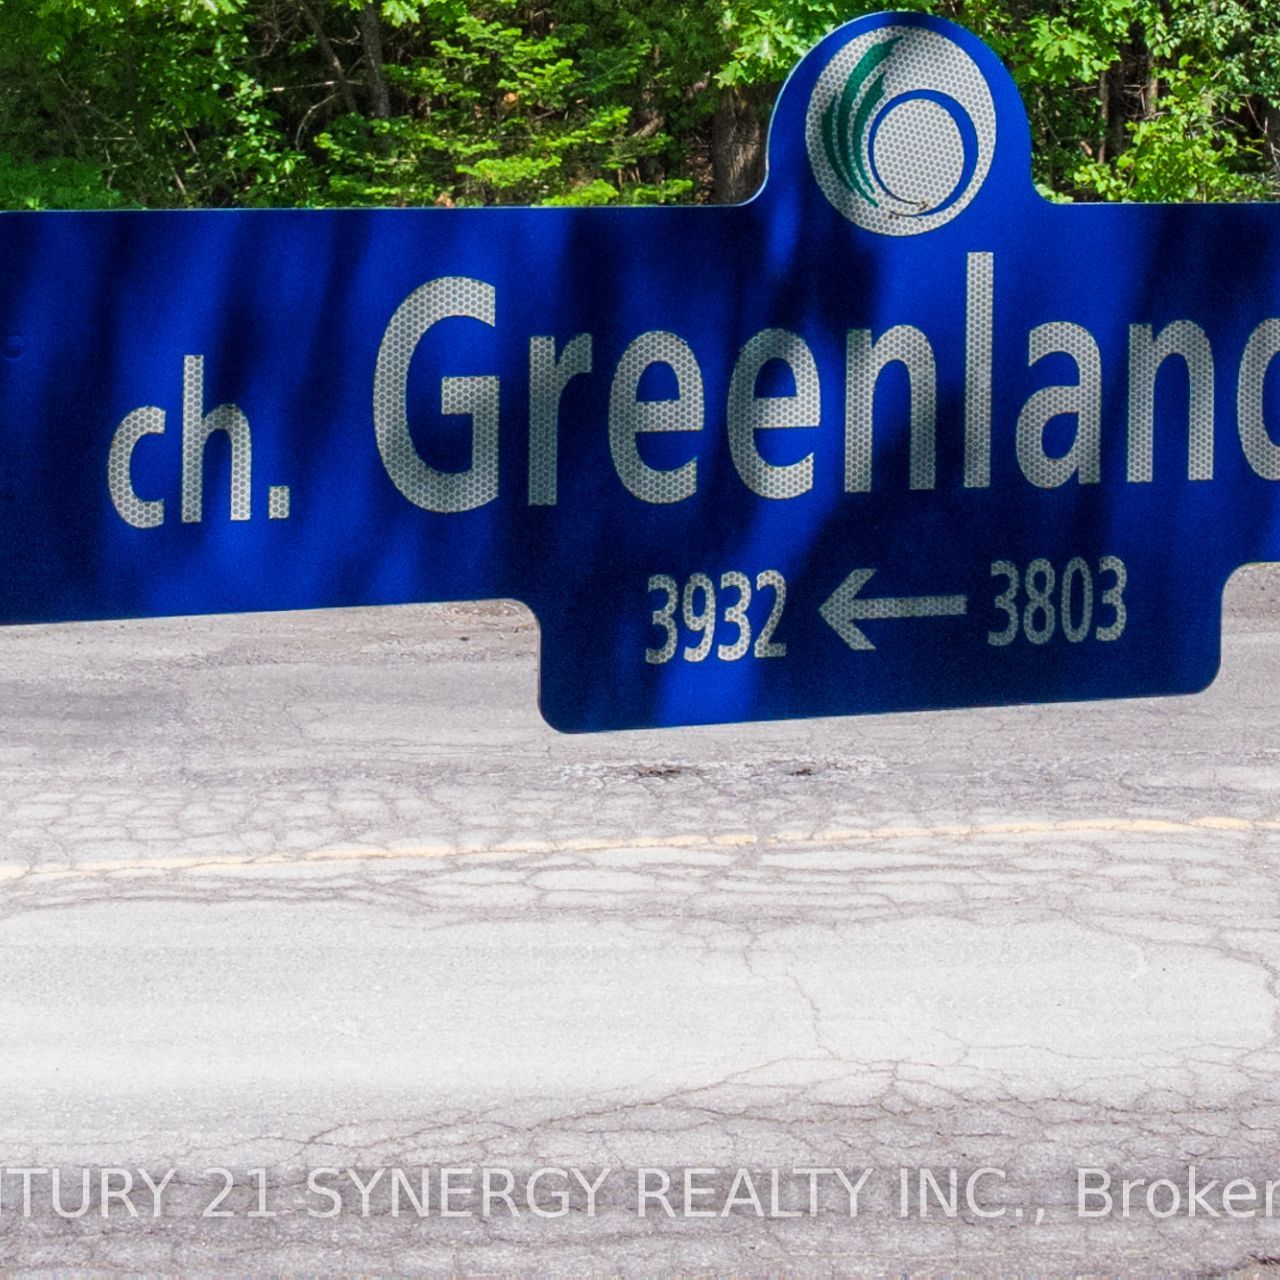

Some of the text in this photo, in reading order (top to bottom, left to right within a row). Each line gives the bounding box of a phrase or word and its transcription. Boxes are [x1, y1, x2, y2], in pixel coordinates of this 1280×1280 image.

[107, 354, 291, 529] ch.
[645, 554, 1128, 664] 3932 3803
